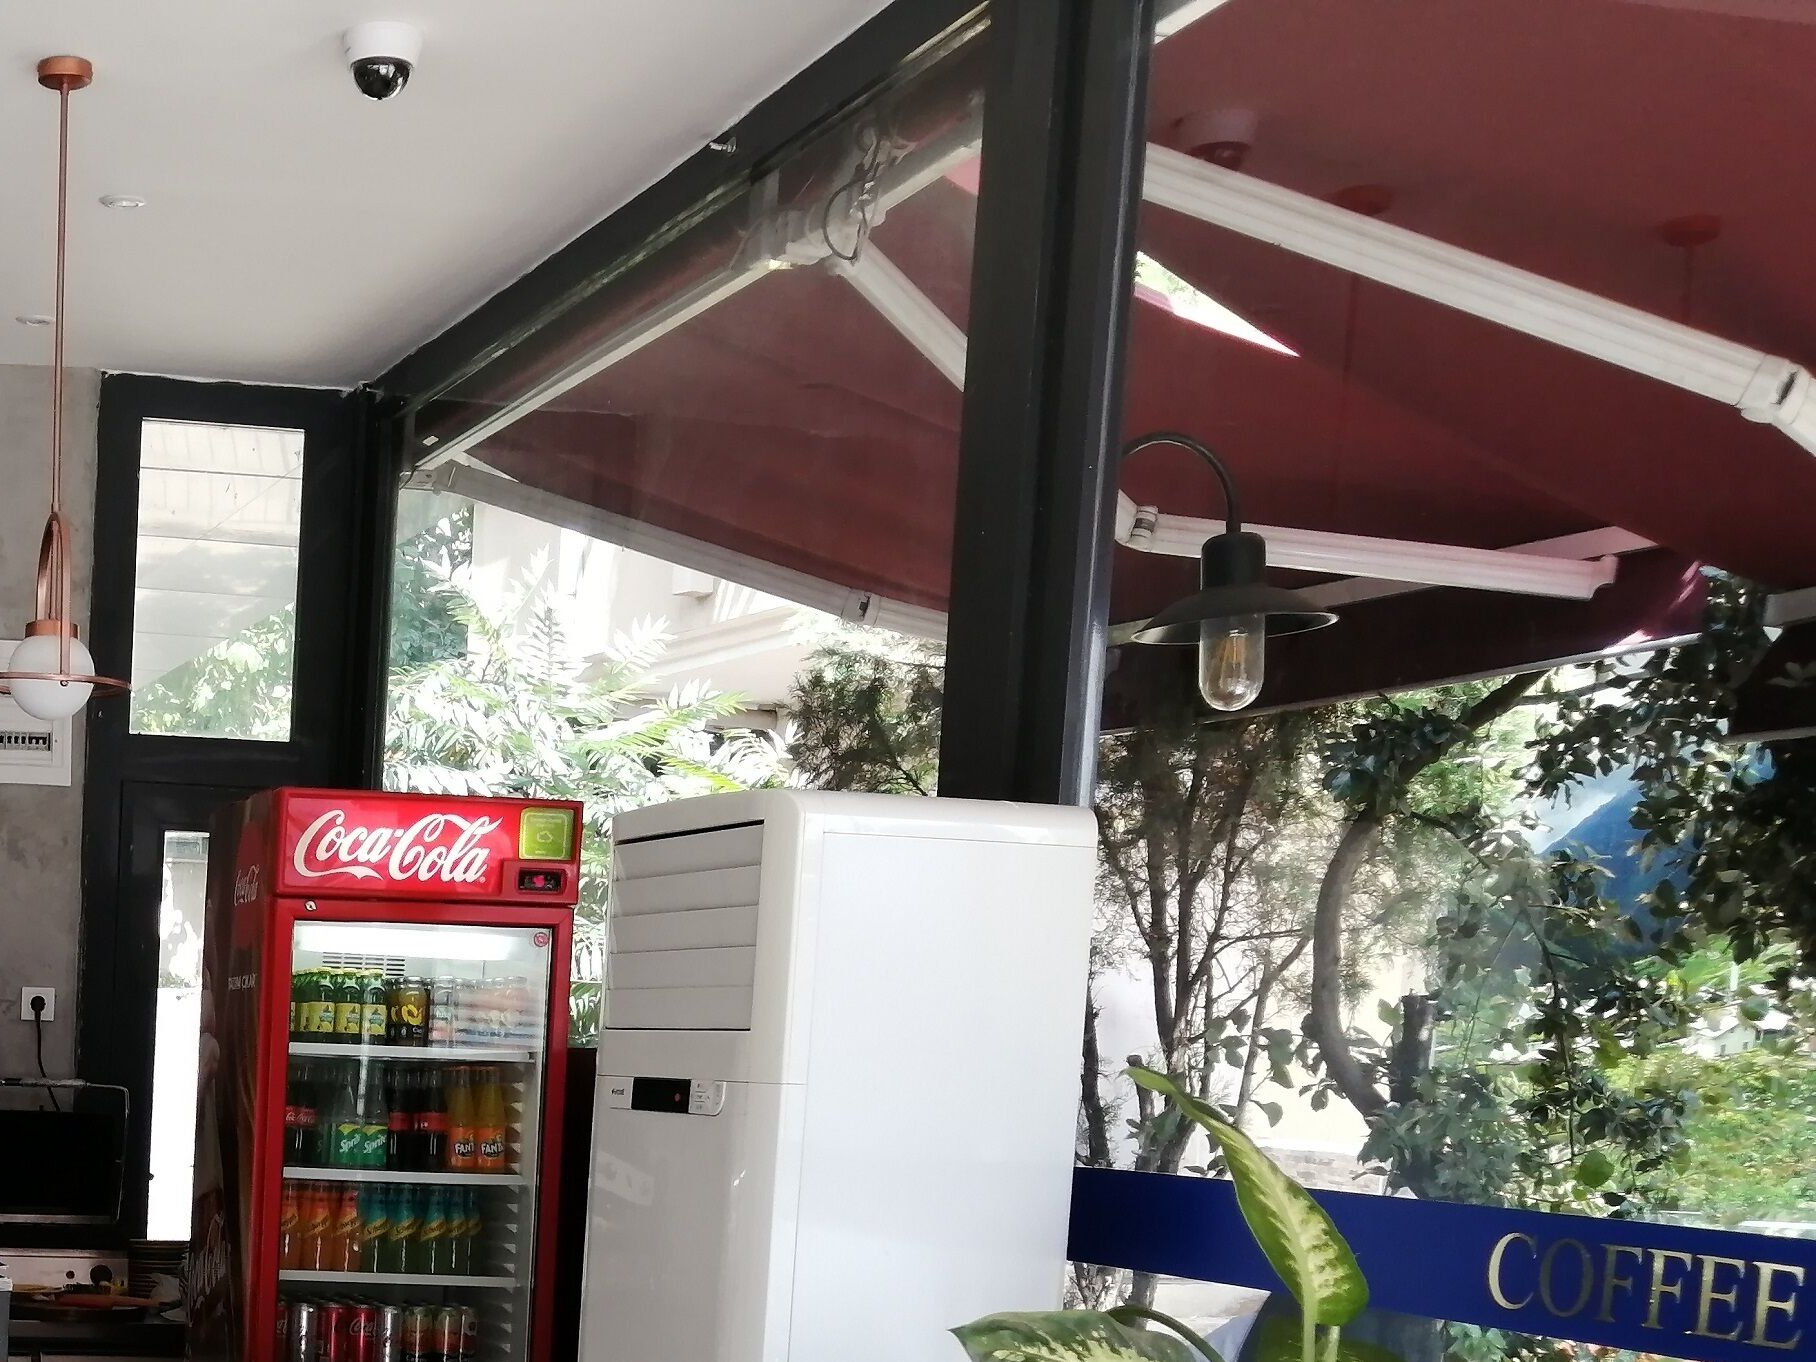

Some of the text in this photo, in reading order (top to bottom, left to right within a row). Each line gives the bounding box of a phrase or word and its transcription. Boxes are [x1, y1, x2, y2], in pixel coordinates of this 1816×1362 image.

[293, 809, 503, 883] Coca-Cola
[454, 1142, 474, 1156] FANT
[1487, 1231, 1807, 1351] COFFEE
